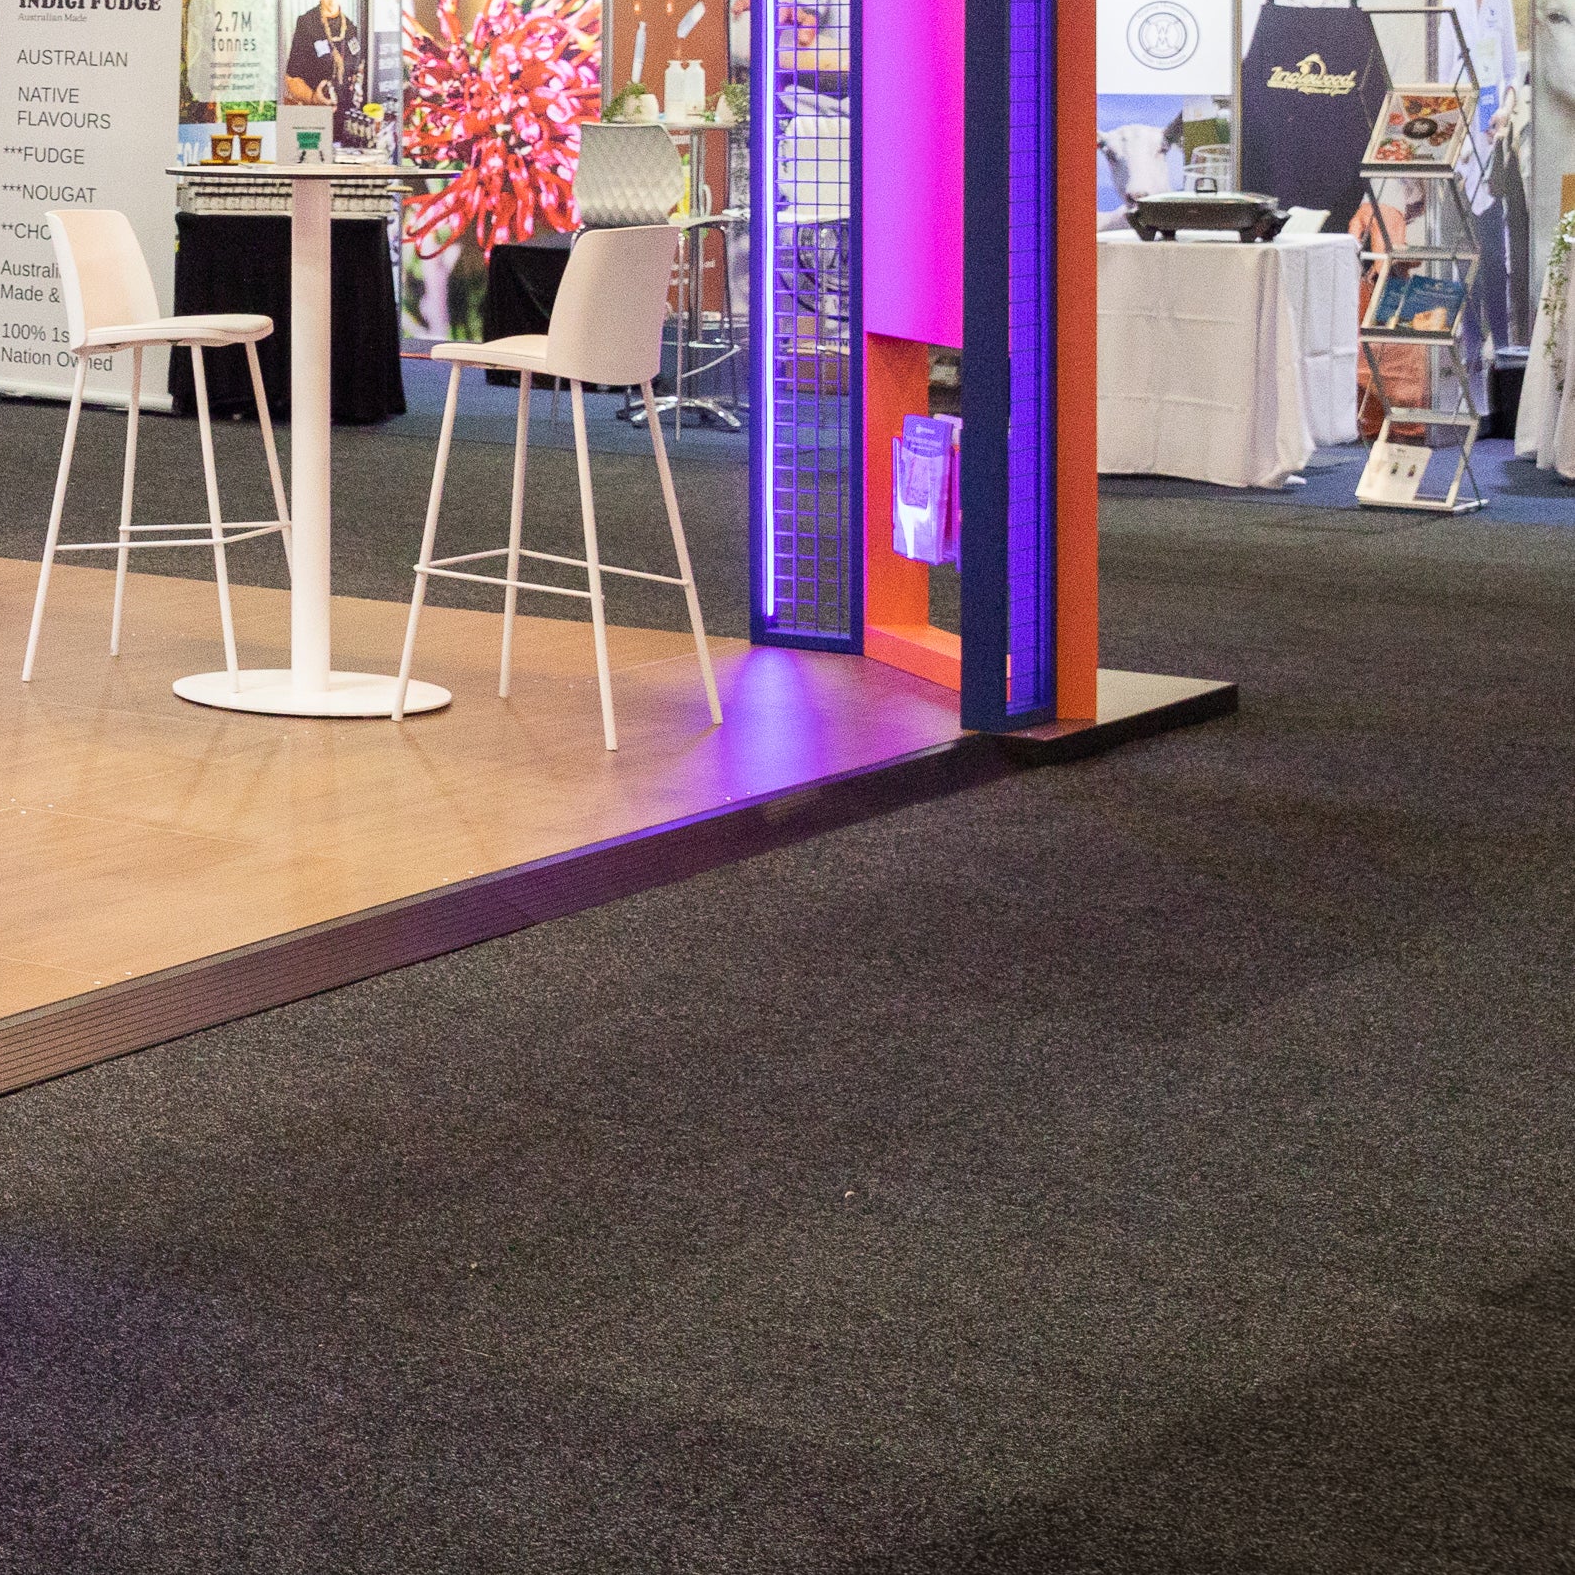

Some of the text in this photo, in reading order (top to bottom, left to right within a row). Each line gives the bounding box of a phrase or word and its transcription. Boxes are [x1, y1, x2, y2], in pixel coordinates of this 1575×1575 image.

[18, 13, 87, 23] Australian Made
[215, 10, 252, 33] 2.7M
[211, 34, 257, 53] tonnes
[17, 49, 128, 67] AUSTRALIAN
[18, 86, 80, 104] NATIVE
[17, 110, 111, 129] FLAVOURS
[1, 284, 60, 303] Made &
[2, 323, 46, 341] 100%
[1, 347, 51, 367] Nation
